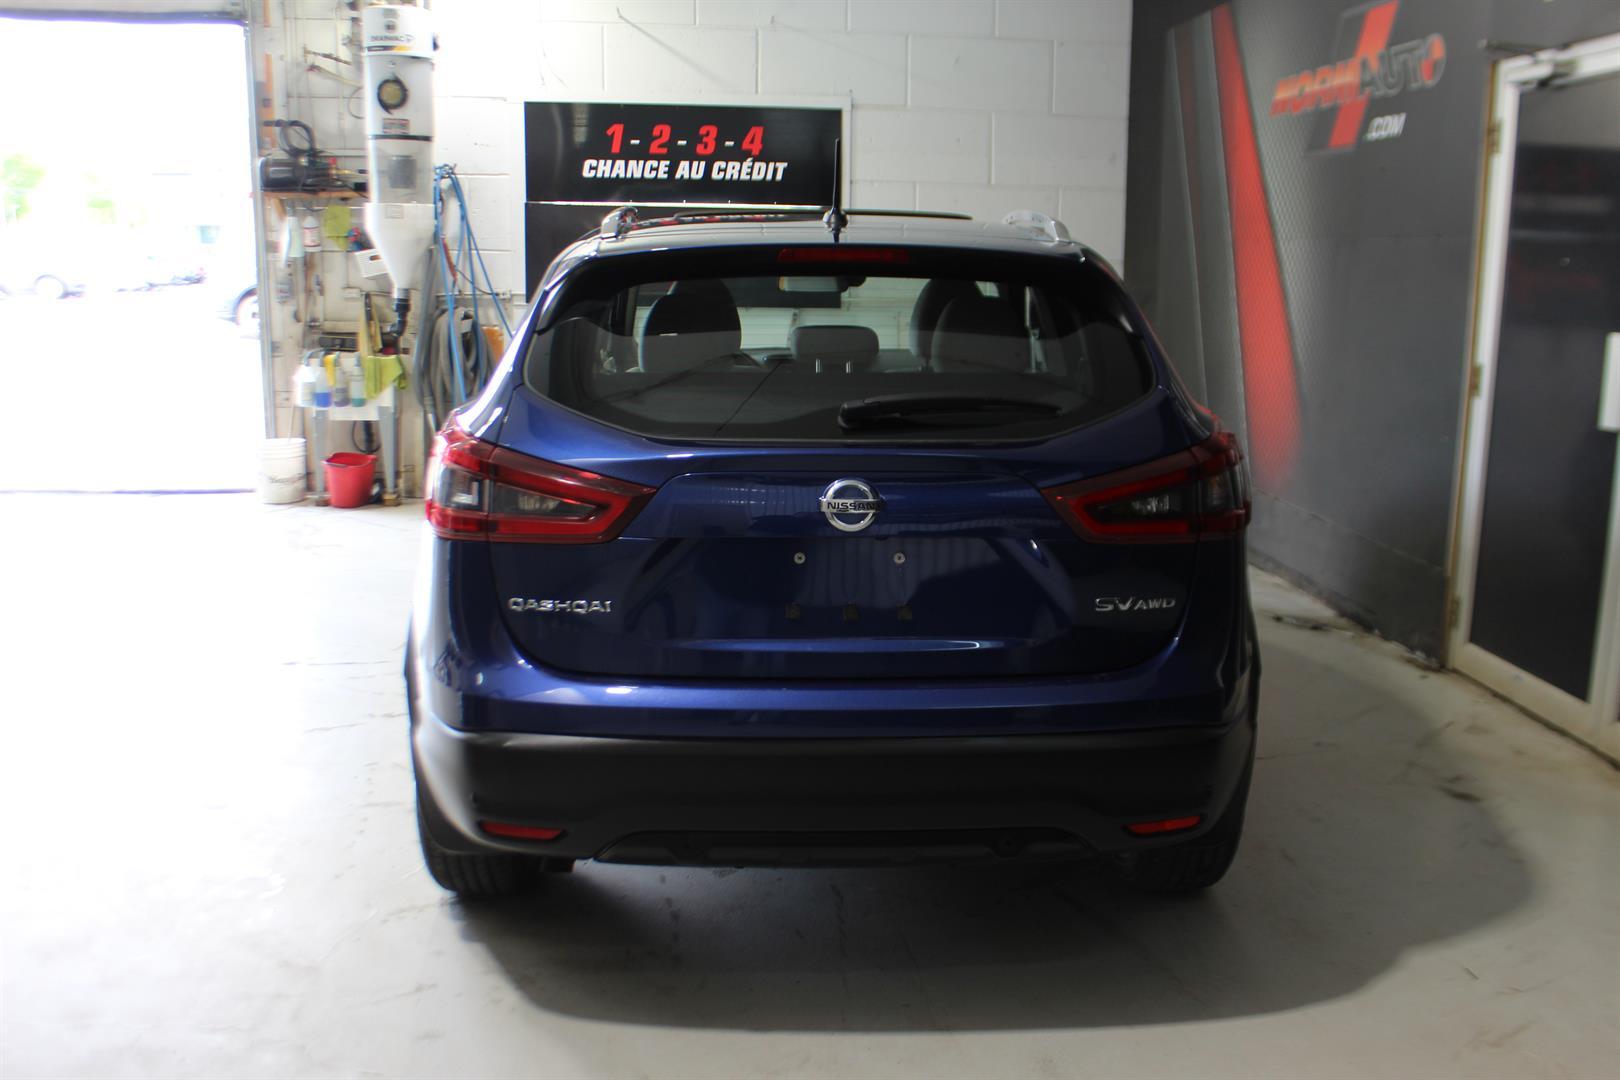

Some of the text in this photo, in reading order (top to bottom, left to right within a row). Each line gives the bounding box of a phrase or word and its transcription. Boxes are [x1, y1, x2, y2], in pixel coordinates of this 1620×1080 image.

[582, 157, 788, 182] CHANCE AU CRÉDIT
[827, 501, 876, 512] NISSAN
[508, 597, 612, 614] QASHQAI
